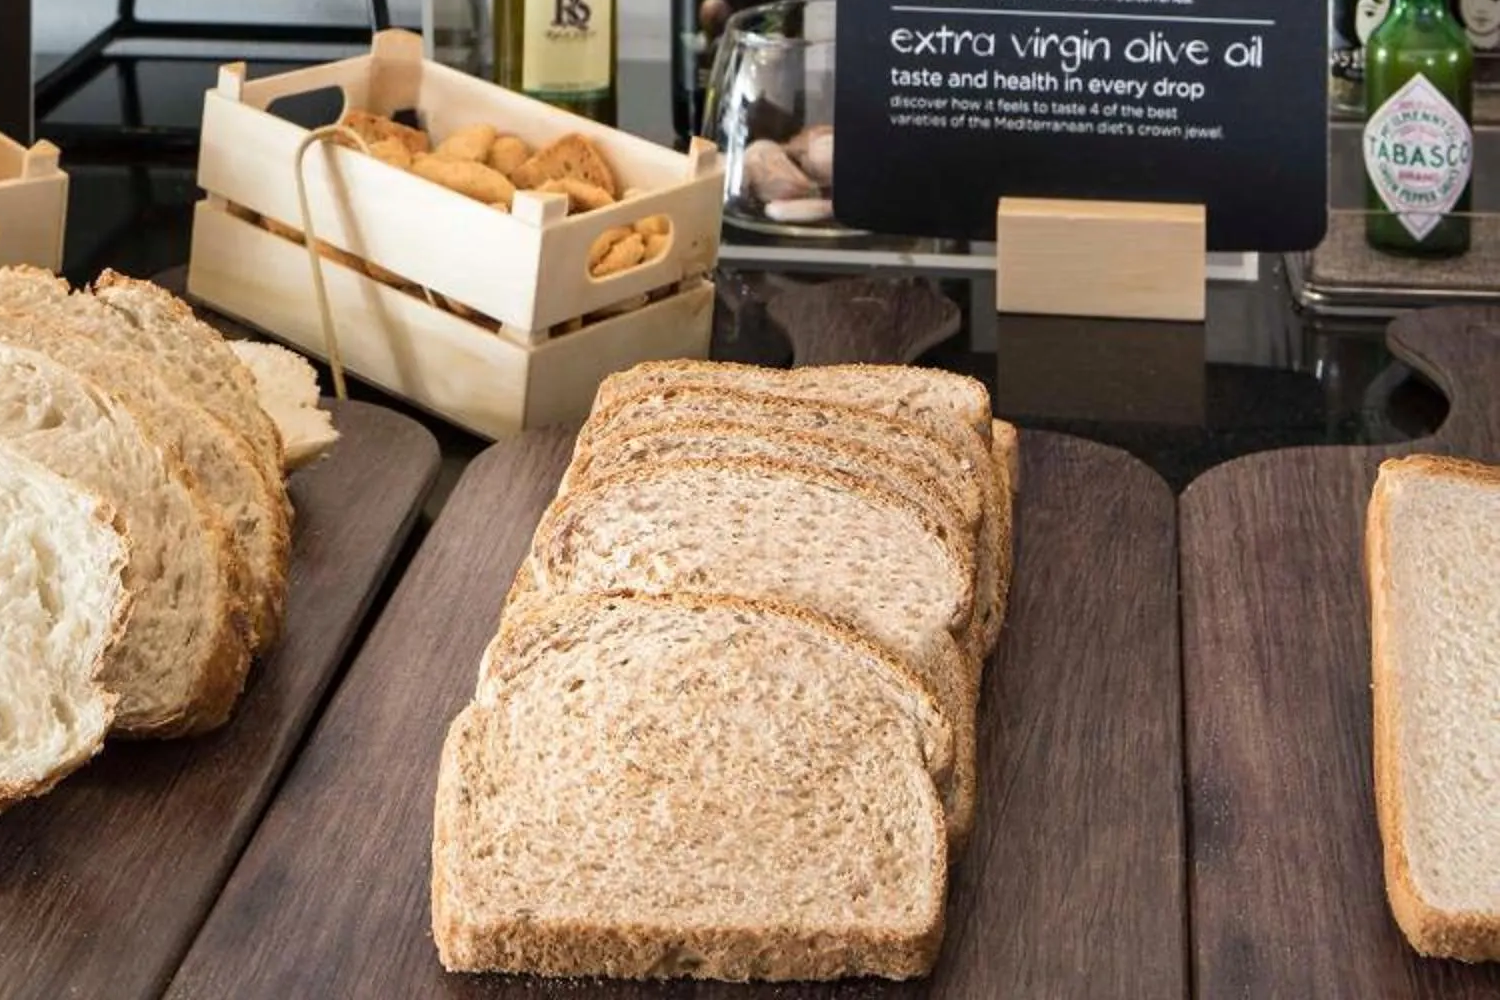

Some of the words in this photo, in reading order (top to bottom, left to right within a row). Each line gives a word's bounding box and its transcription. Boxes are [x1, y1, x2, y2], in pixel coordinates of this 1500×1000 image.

[890, 24, 996, 56] extra
[1010, 27, 1111, 73] virgin
[1124, 31, 1209, 64] olive
[1224, 35, 1263, 69] oil
[891, 67, 943, 87] taste
[948, 69, 988, 88] and
[993, 70, 1059, 91] health
[1064, 73, 1083, 92] in
[1088, 78, 1148, 99] every
[1153, 77, 1205, 101] drop
[890, 95, 948, 109] discover
[951, 97, 981, 110] how
[984, 98, 994, 111] it
[998, 98, 1029, 112] feels
[1033, 101, 1049, 114] to
[1052, 102, 1086, 115] taste
[1089, 103, 1100, 115] 4
[1102, 103, 1118, 117] of
[1121, 104, 1144, 118] the
[1147, 106, 1178, 120] best
[890, 114, 946, 128] varieties
[951, 115, 965, 128] of
[968, 115, 990, 129] the
[994, 116, 1093, 134] Mediterranean
[1097, 121, 1134, 135] diet's
[1137, 124, 1182, 138] crown
[1366, 135, 1470, 168] TABASCO
